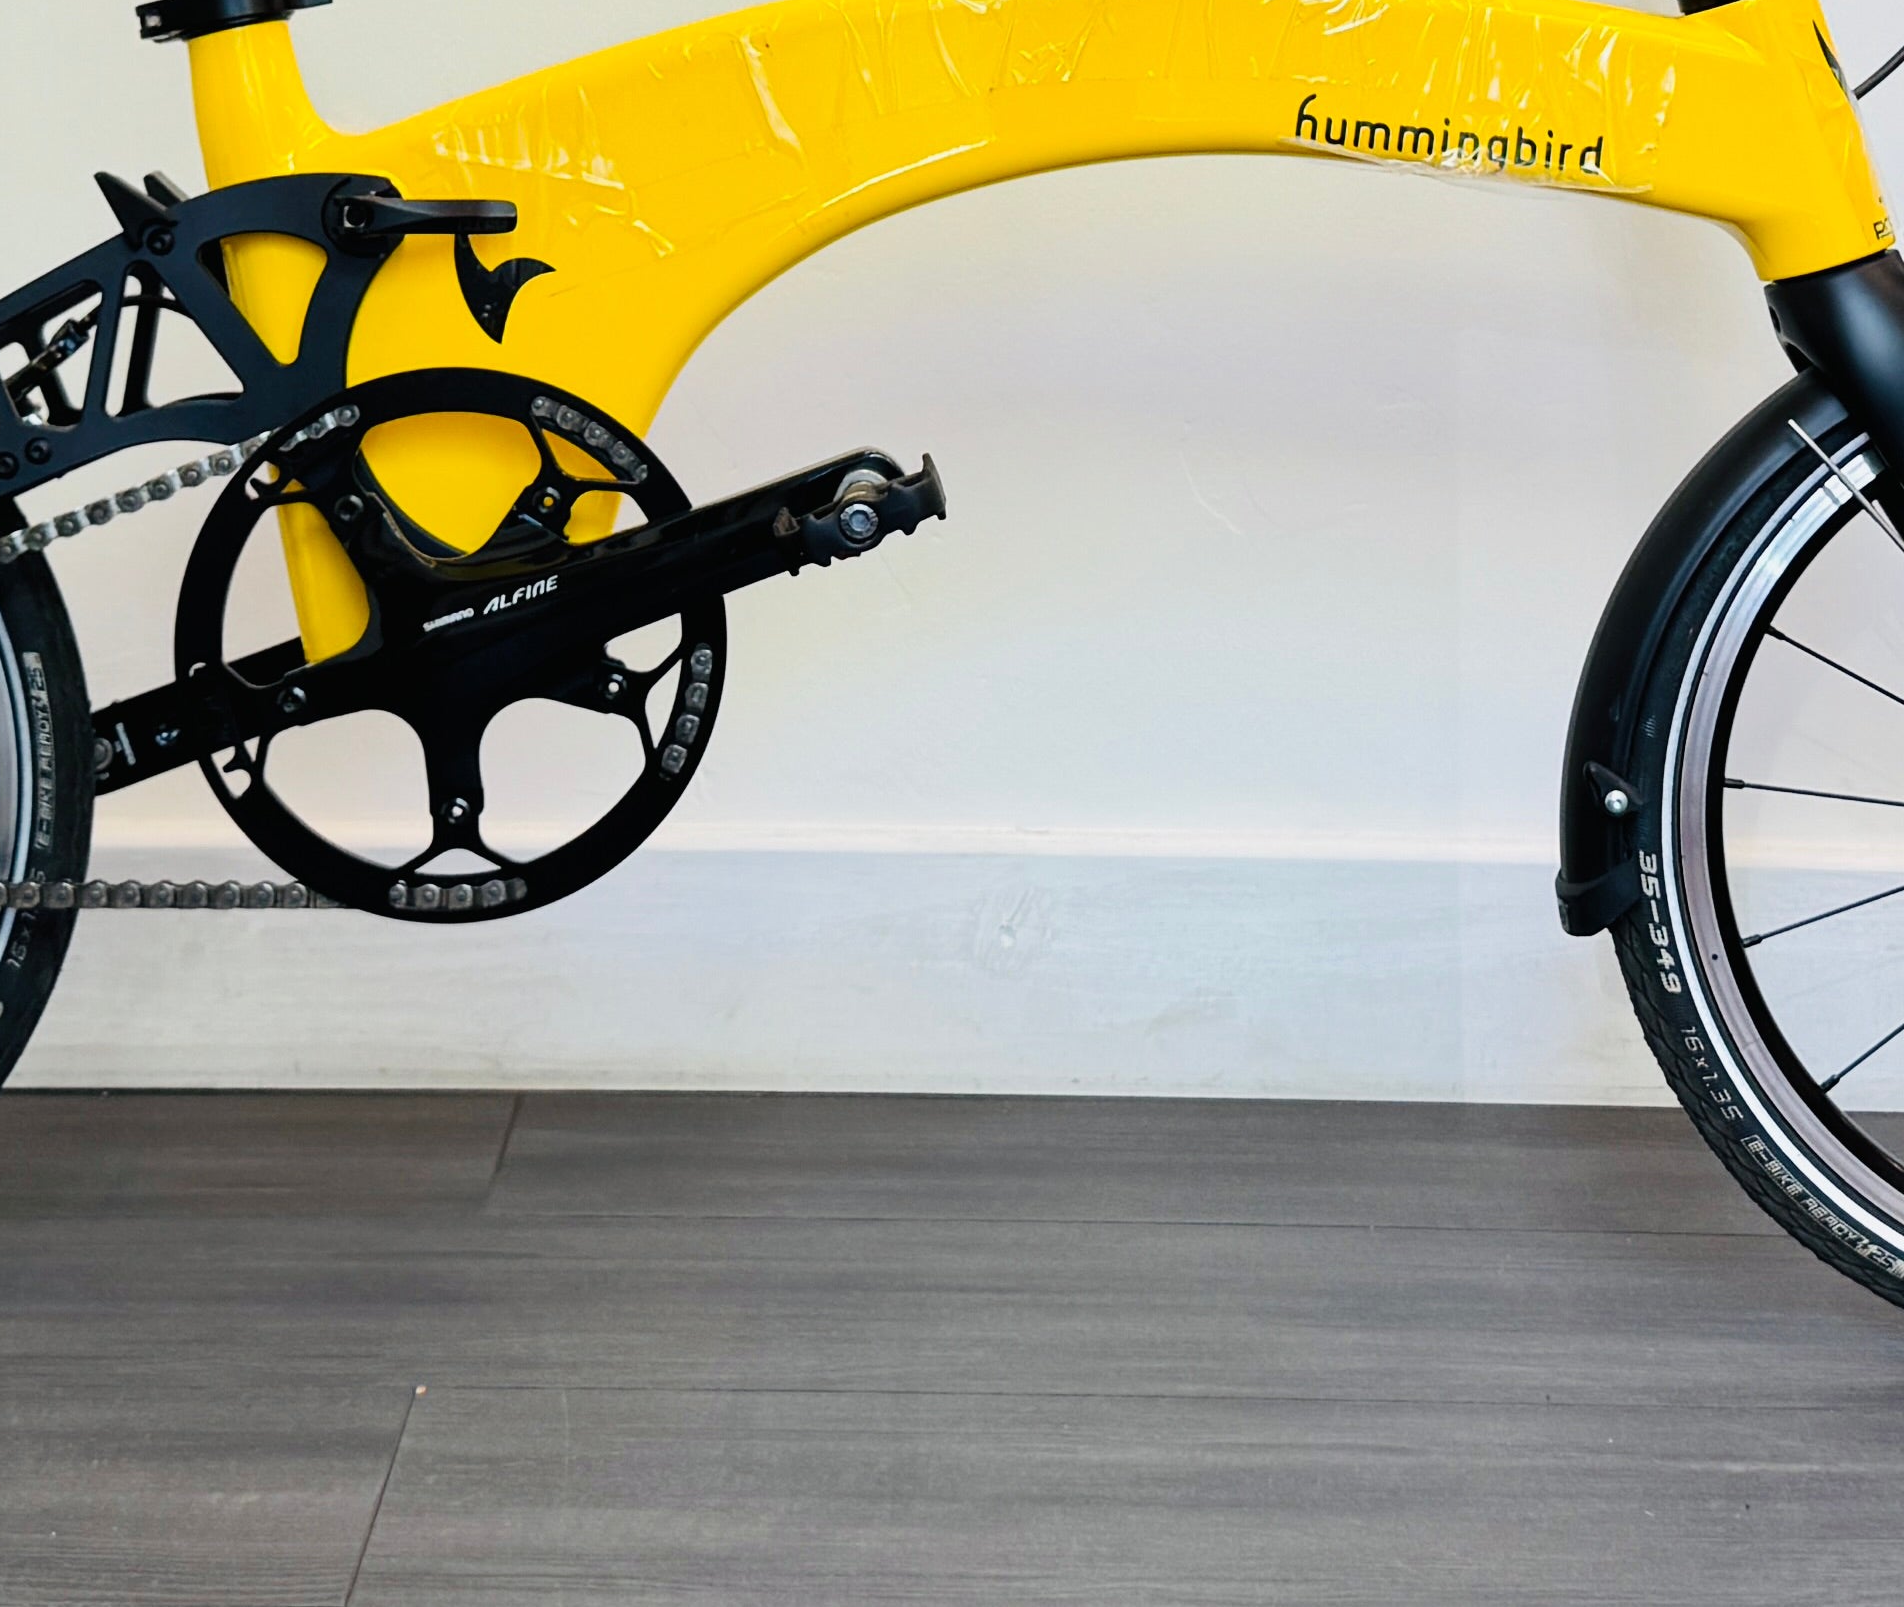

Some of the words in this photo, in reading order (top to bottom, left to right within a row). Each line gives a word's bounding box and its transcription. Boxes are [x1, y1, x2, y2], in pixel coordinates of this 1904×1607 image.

[1295, 93, 1604, 174] hummingbird
[422, 607, 475, 633] SHIMANO
[483, 574, 559, 615] ALFINE
[1638, 849, 1683, 995] 35-349
